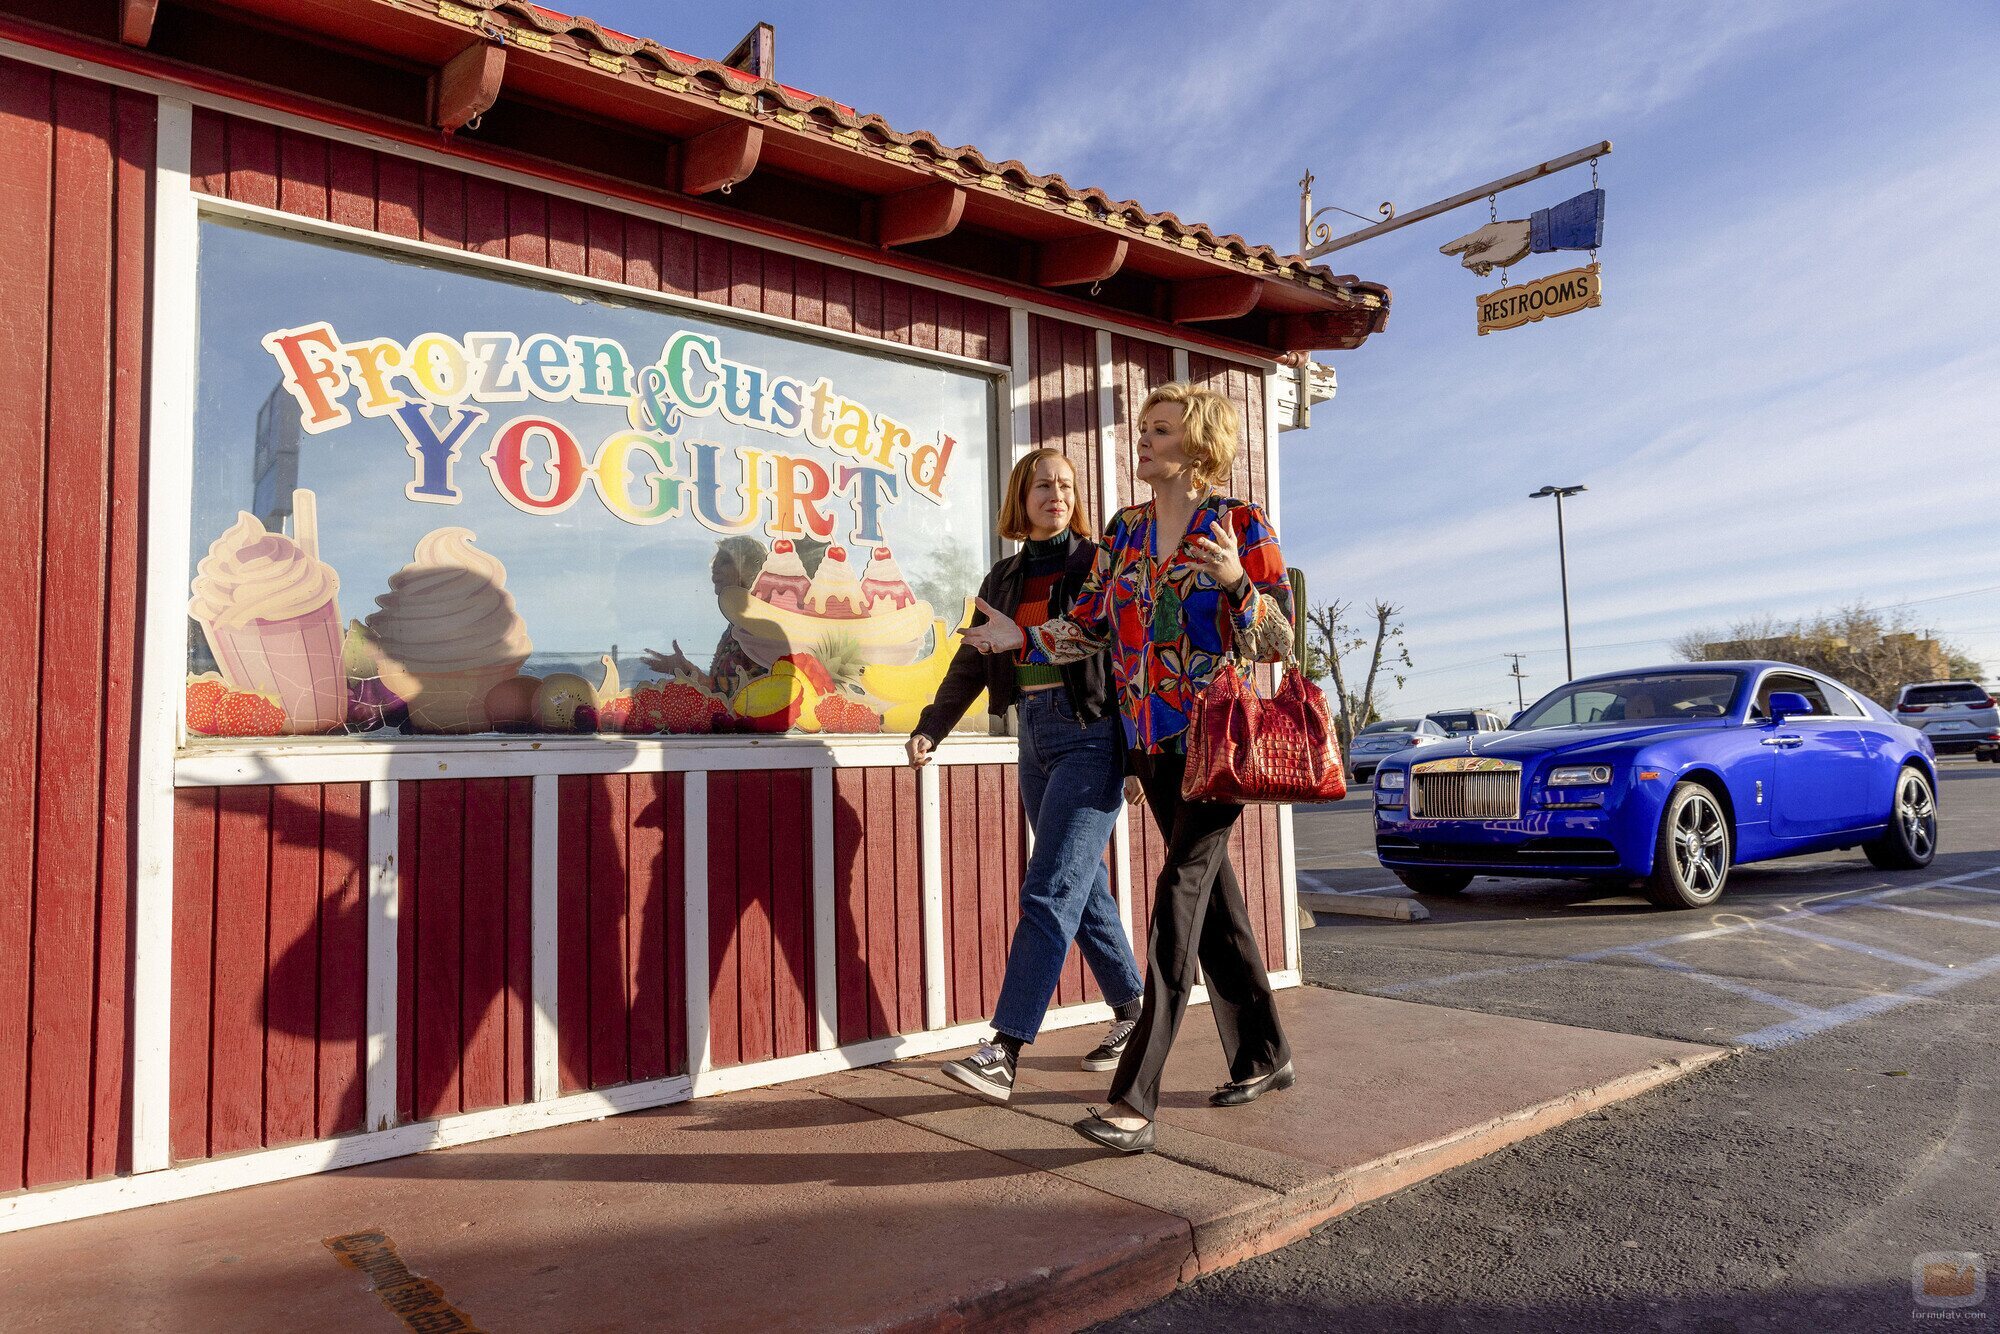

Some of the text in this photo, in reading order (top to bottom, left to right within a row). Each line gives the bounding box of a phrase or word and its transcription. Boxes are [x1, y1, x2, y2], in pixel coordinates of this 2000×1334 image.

[1482, 277, 1588, 323] RESTROOMS
[270, 326, 960, 499] Frozen & Custard
[399, 402, 900, 546] YOGURT
